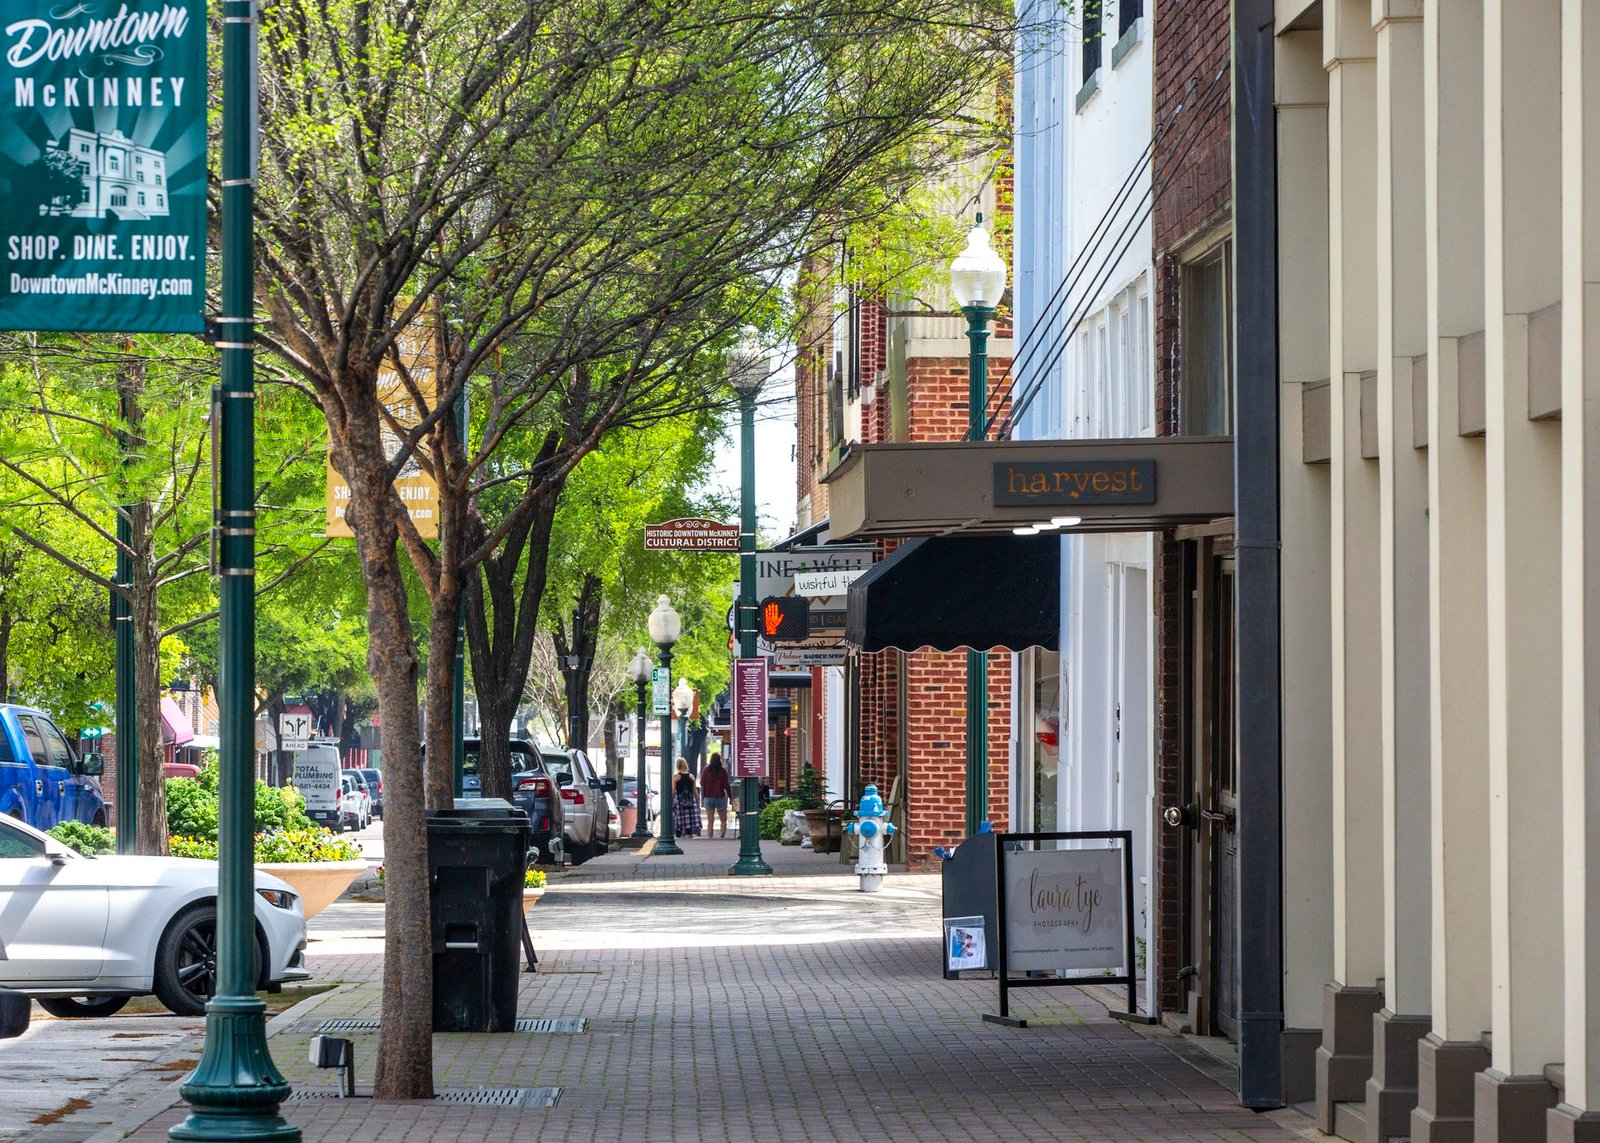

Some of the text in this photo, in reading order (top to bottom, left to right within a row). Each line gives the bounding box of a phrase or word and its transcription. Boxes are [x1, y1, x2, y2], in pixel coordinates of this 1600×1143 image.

[6, 3, 190, 68] Downtown
[15, 77, 185, 107] McKINNEY
[8, 235, 196, 261] SHOP. DINE. ENJOY.
[10, 273, 193, 300] DowntownMcKinney.com
[1007, 464, 1143, 494] harvest
[400, 486, 433, 500] ENJOY.
[647, 538, 738, 546] CULTURAL DISTRICT
[760, 560, 793, 578] INE
[799, 576, 837, 591] wishful
[1030, 868, 1102, 933] laura tye
[1033, 920, 1079, 928] PHOTOGRAPHY
